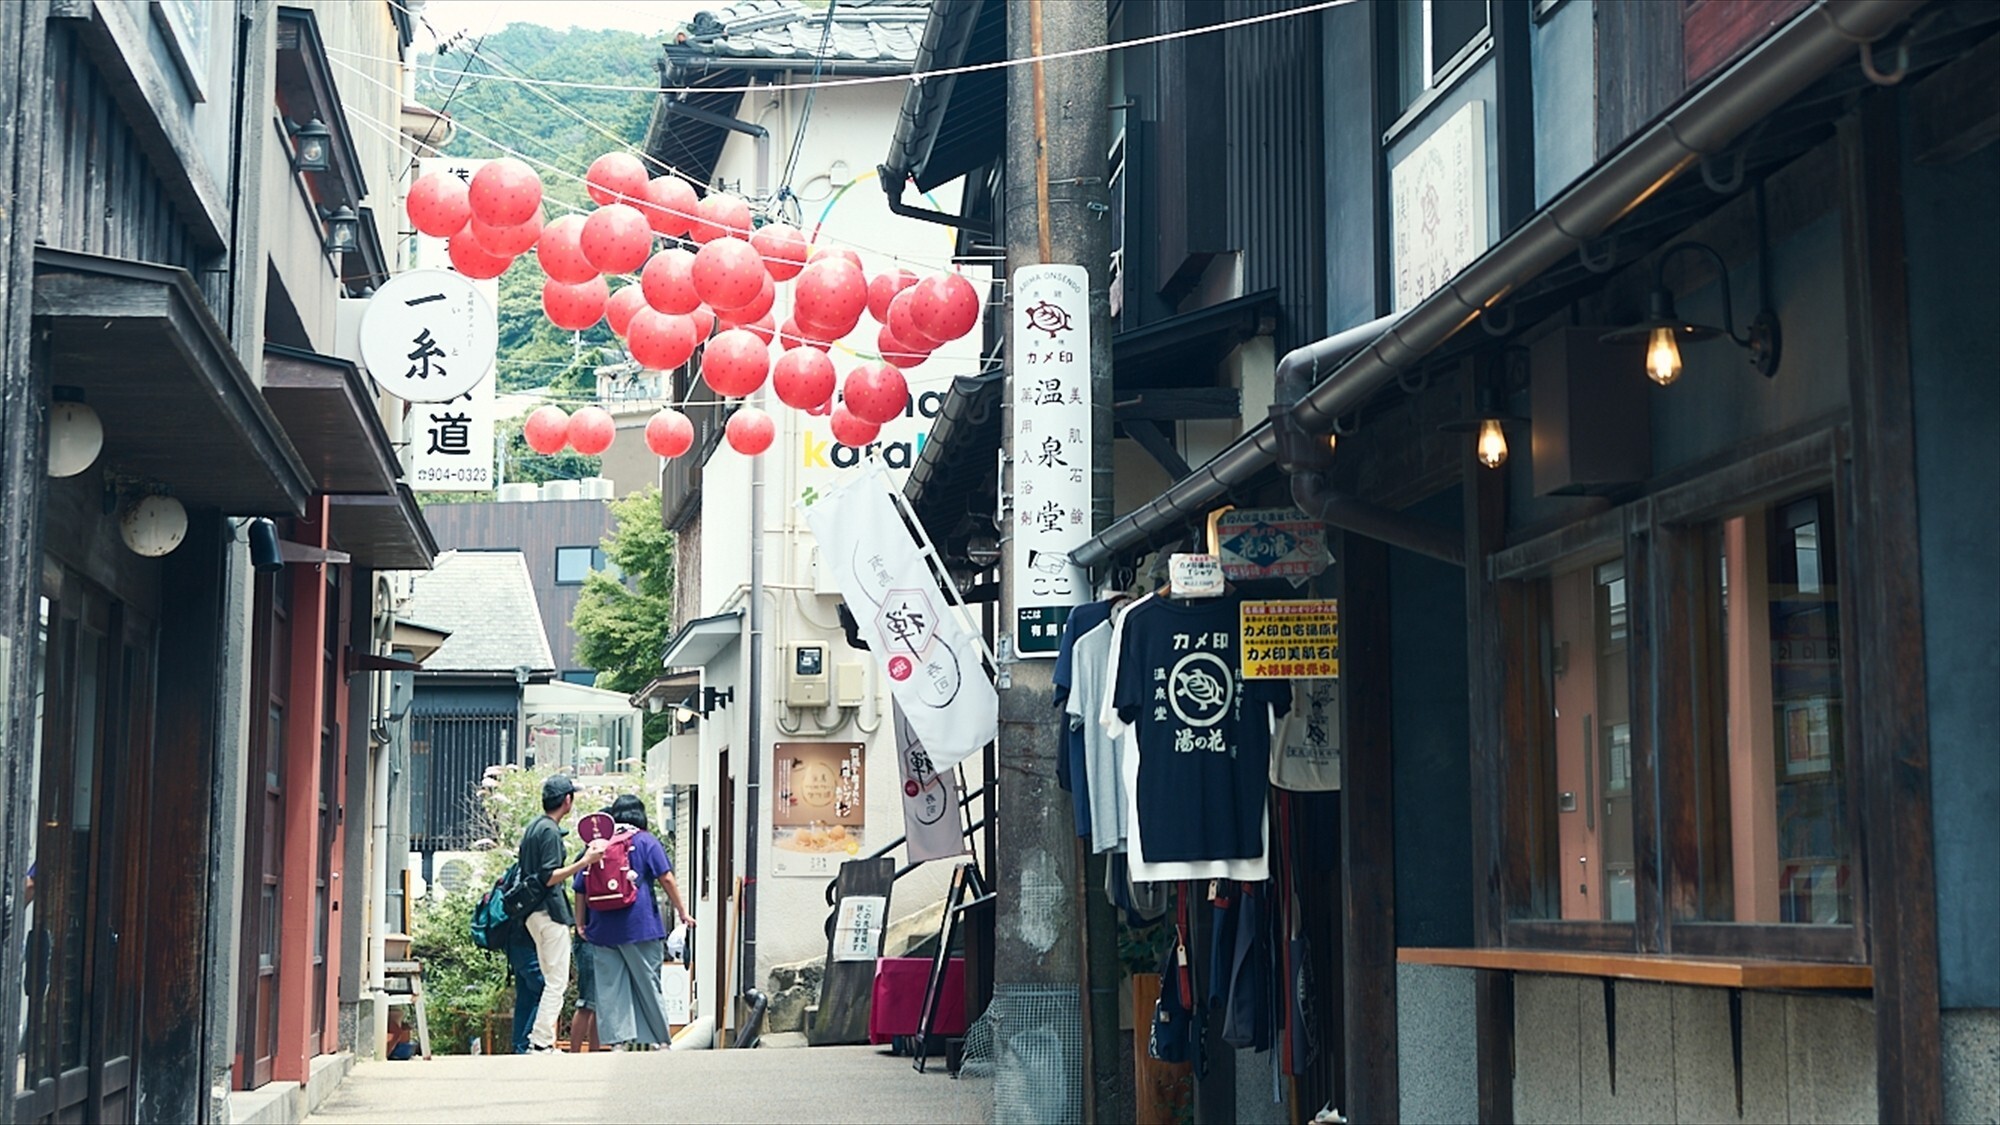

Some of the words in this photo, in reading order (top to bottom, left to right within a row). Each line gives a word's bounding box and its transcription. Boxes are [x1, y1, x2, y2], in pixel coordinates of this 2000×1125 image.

[1044, 272, 1081, 294] ONSENDO
[404, 292, 447, 380] 一糸
[1027, 350, 1073, 364] カメ印
[1020, 386, 1034, 527] 薬用入浴剤
[1034, 378, 1068, 534] 温泉堂
[1067, 386, 1084, 526] 美肌石鹸
[1032, 578, 1072, 596] ここ
[1020, 609, 1041, 620] ここは
[1030, 623, 1067, 637] 有馬
[1172, 632, 1229, 650] カメ印
[1153, 667, 1168, 721] 温泉堂
[1174, 727, 1227, 753] 湯の花
